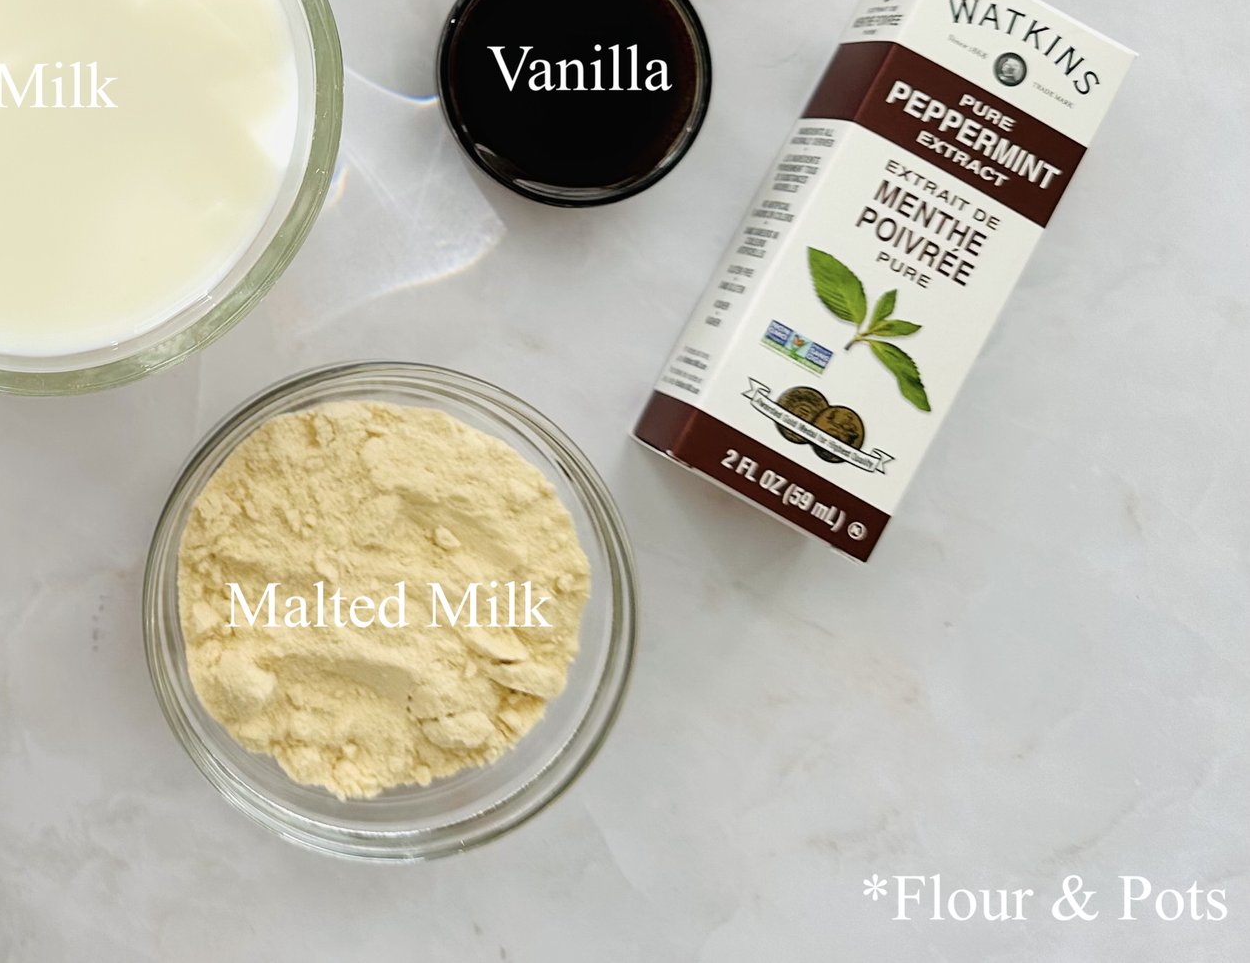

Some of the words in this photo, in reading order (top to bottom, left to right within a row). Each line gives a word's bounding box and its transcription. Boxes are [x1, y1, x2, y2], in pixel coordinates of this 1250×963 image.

[885, 80, 1062, 189] PEPPERMINT
[958, 93, 1017, 132] PURE
[884, 159, 970, 211] EXTRAIT
[973, 208, 1002, 231] DE
[916, 130, 1010, 187] EXTRACT
[855, 206, 975, 286] POIVRÉE
[873, 180, 987, 256] MENTHE
[876, 251, 932, 288] PURE
[721, 449, 739, 469] 2
[735, 456, 759, 483] FL
[759, 469, 788, 496] OZ
[782, 483, 815, 511] (59
[810, 502, 846, 533] mL)
